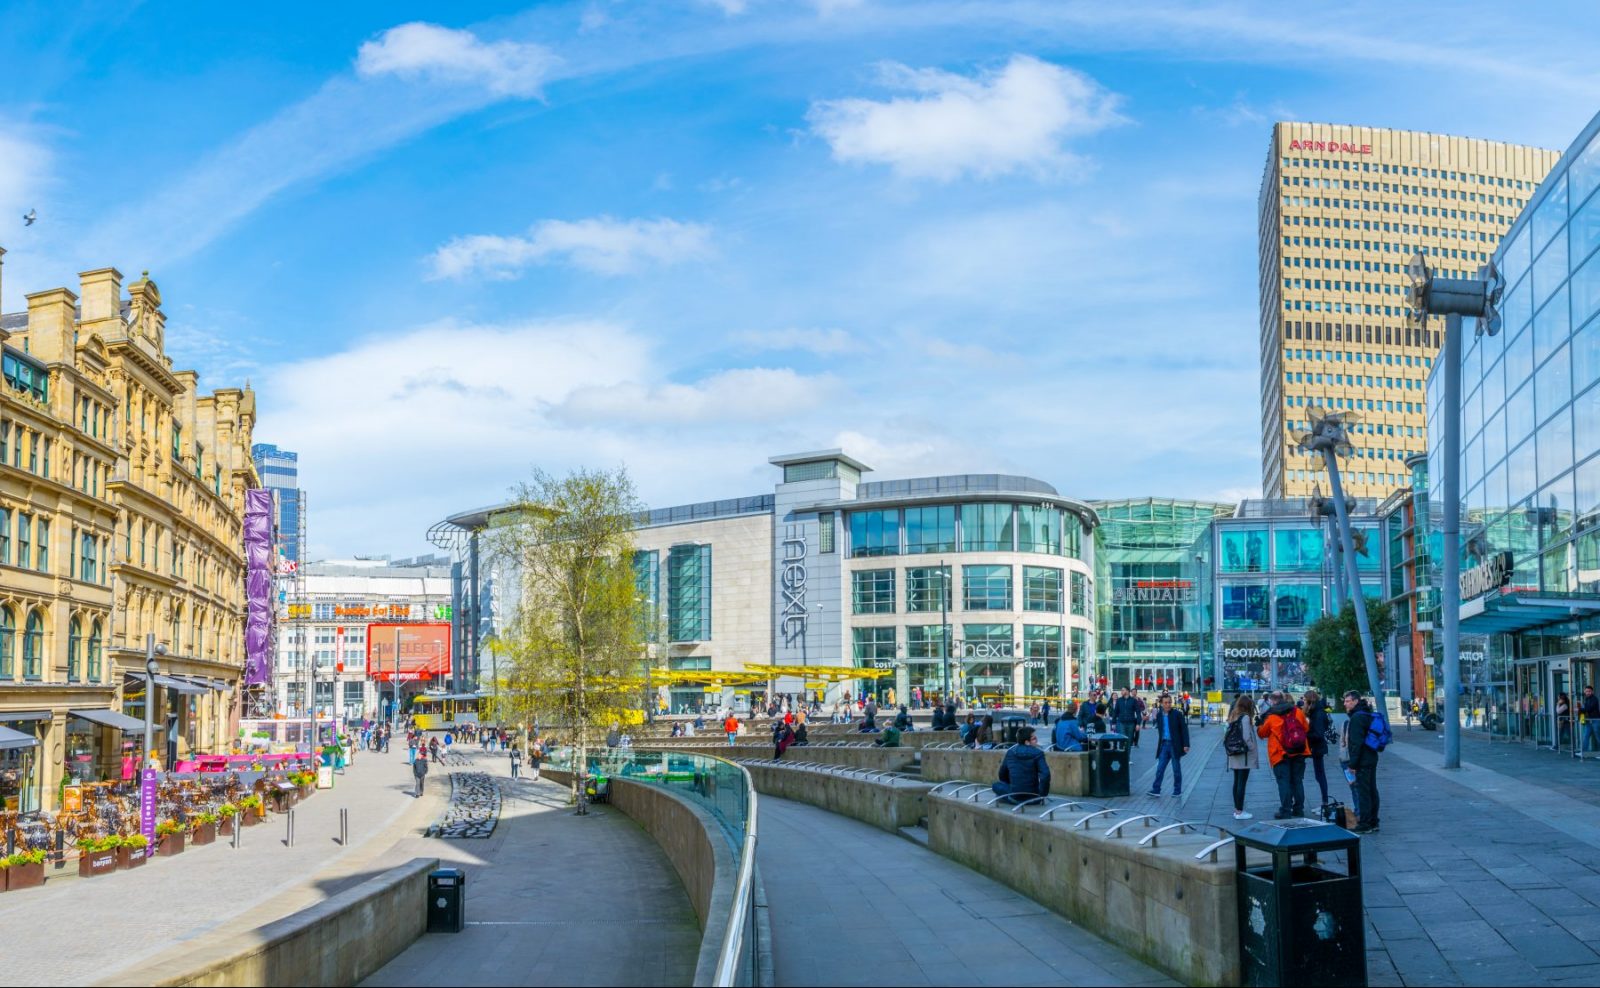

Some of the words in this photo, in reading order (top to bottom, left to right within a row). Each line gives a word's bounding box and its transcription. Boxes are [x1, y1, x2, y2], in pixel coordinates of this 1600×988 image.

[1290, 139, 1372, 155] ARNDALE
[783, 537, 809, 632] next
[1113, 587, 1192, 601] ARNDALE
[963, 643, 1011, 657] next
[1225, 648, 1296, 658] FOOTASYLUM
